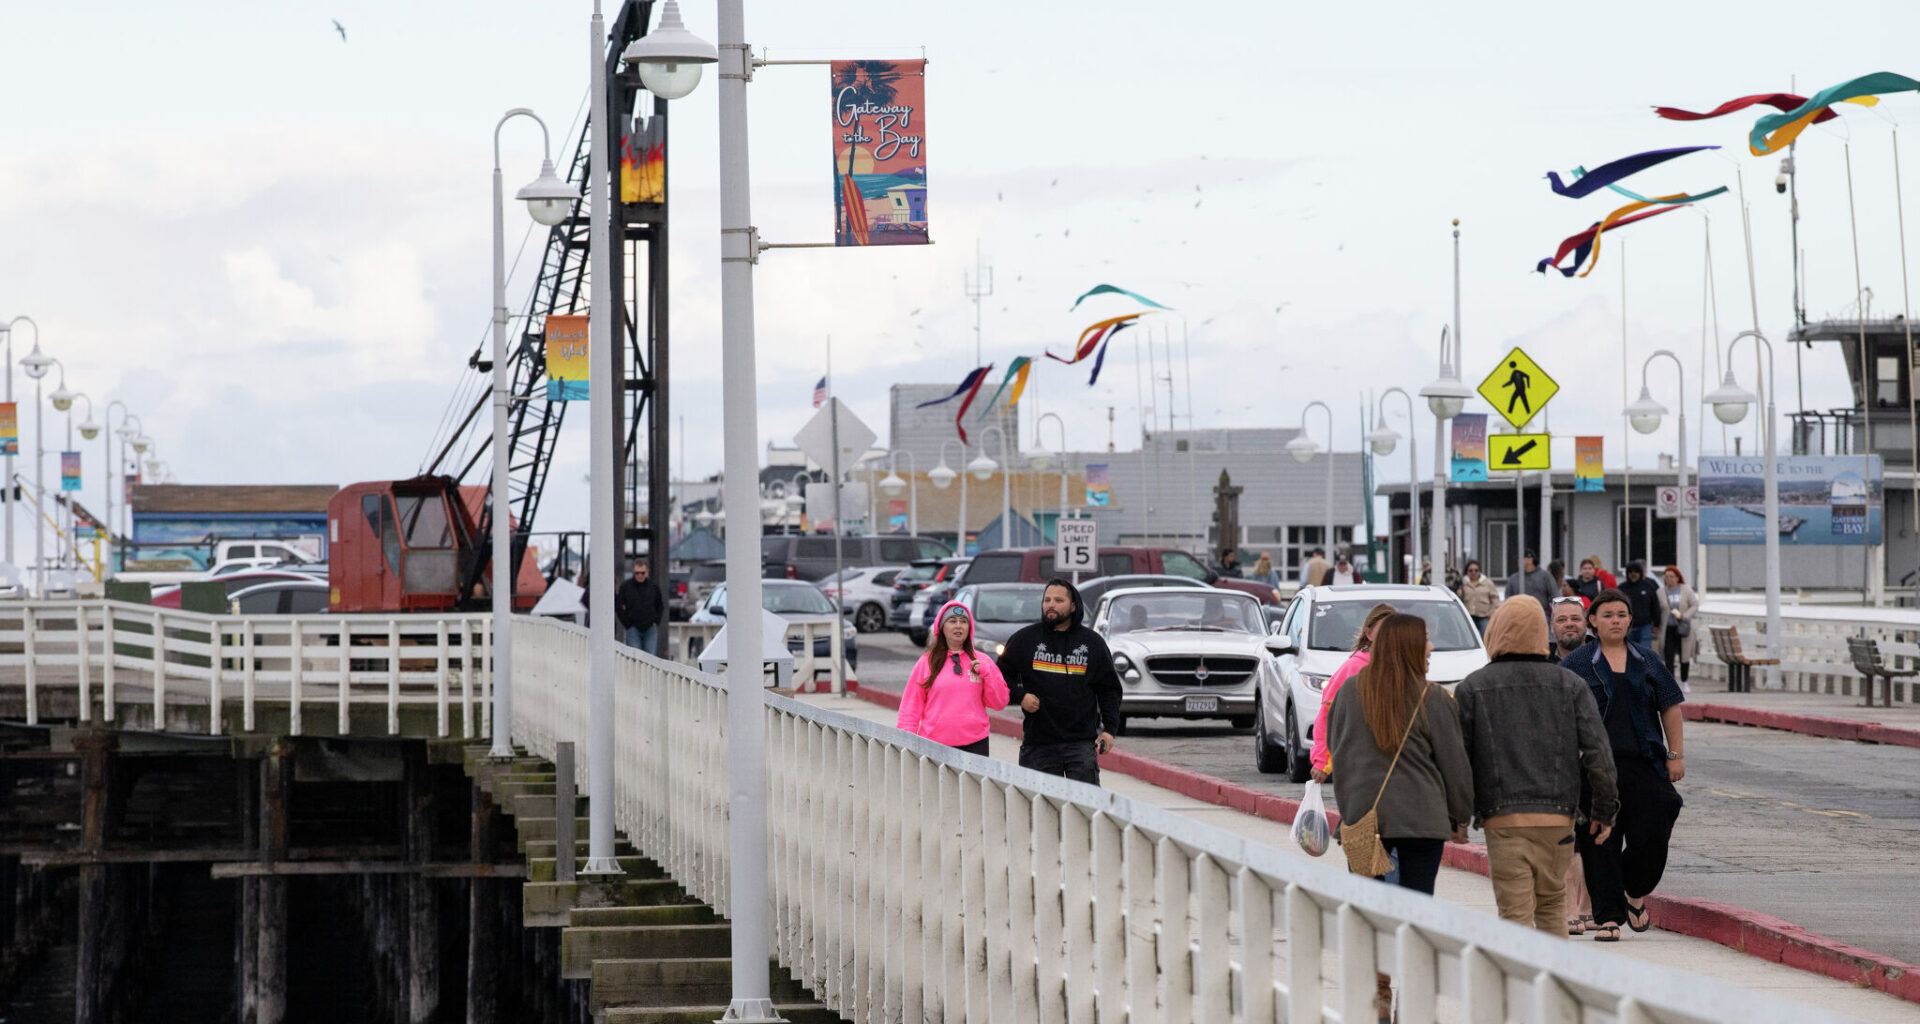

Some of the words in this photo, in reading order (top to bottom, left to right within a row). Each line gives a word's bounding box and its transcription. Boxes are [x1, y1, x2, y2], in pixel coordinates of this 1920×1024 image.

[836, 86, 912, 128] Gateway
[843, 133, 853, 143] to
[853, 125, 872, 143] the
[874, 114, 922, 160] Bay
[1709, 461, 1784, 474] WELCOE
[1789, 465, 1802, 474] TO
[1805, 465, 1824, 474] THE
[1060, 524, 1094, 534] SPEED
[1843, 523, 1864, 534] BAY
[1063, 535, 1090, 544] LIMIT
[1063, 546, 1090, 565] 15
[1033, 650, 1062, 664] SANTA
[1065, 655, 1088, 666] CRUZ
